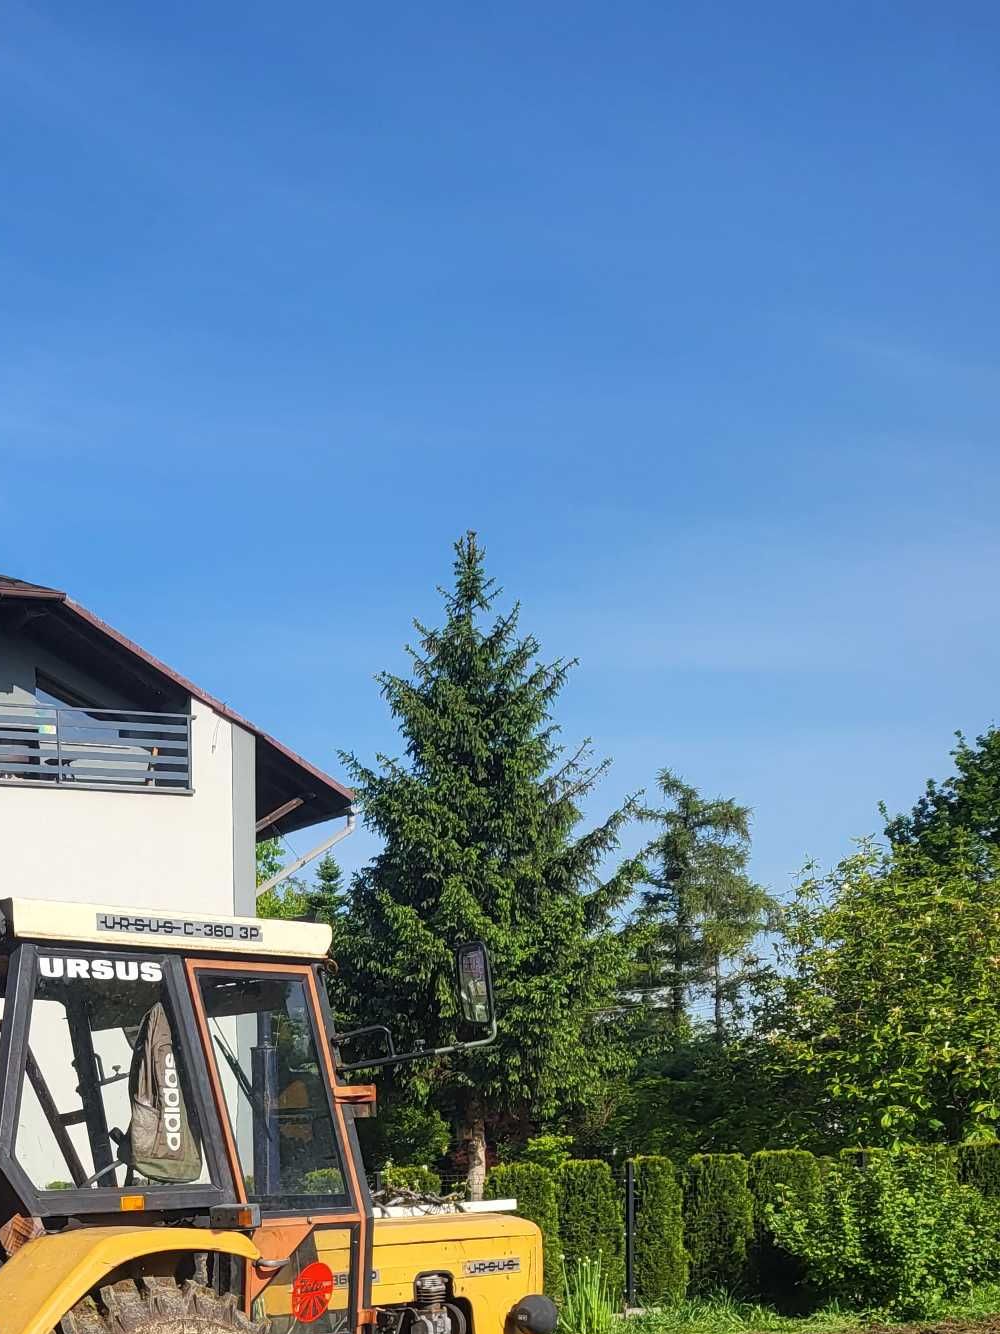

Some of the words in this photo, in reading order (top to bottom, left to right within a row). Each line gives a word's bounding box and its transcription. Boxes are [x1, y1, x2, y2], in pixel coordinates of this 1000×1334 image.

[102, 915, 179, 934] URSUS
[183, 922, 234, 938] C-360
[239, 926, 260, 940] 3P
[39, 957, 163, 982] URSUS
[163, 1053, 181, 1152] adidas
